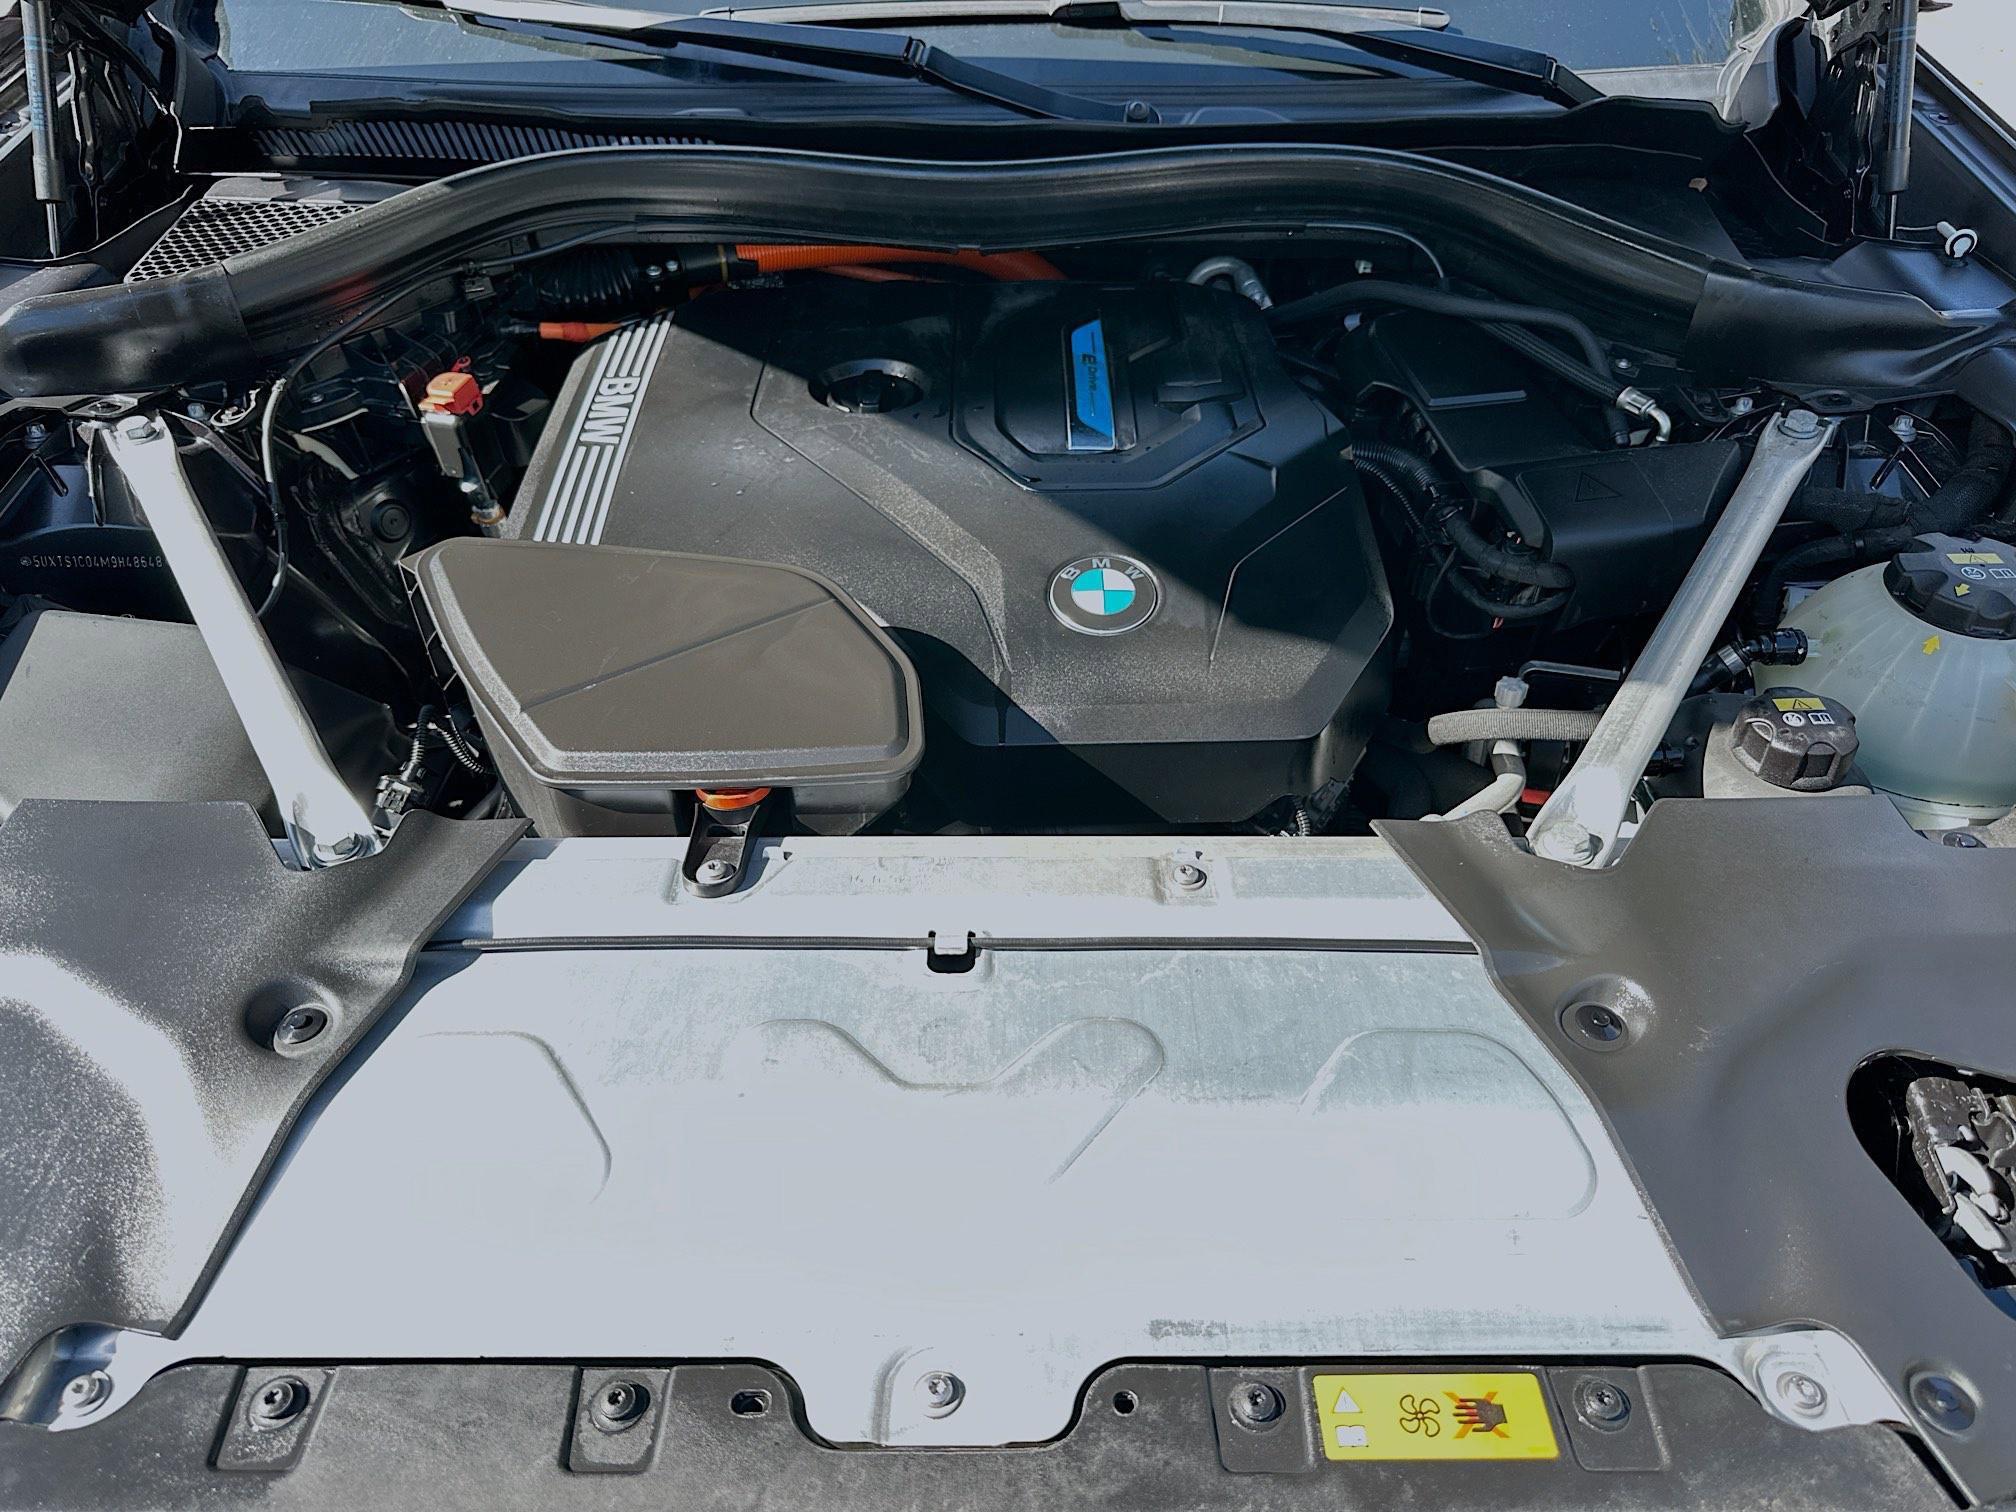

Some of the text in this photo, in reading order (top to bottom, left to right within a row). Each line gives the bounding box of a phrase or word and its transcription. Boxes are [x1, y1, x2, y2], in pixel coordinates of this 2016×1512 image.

[579, 376, 641, 445] BMW
[32, 555, 163, 568] 5UXTS1C04M9H48648
[1060, 558, 1145, 581] BMW
